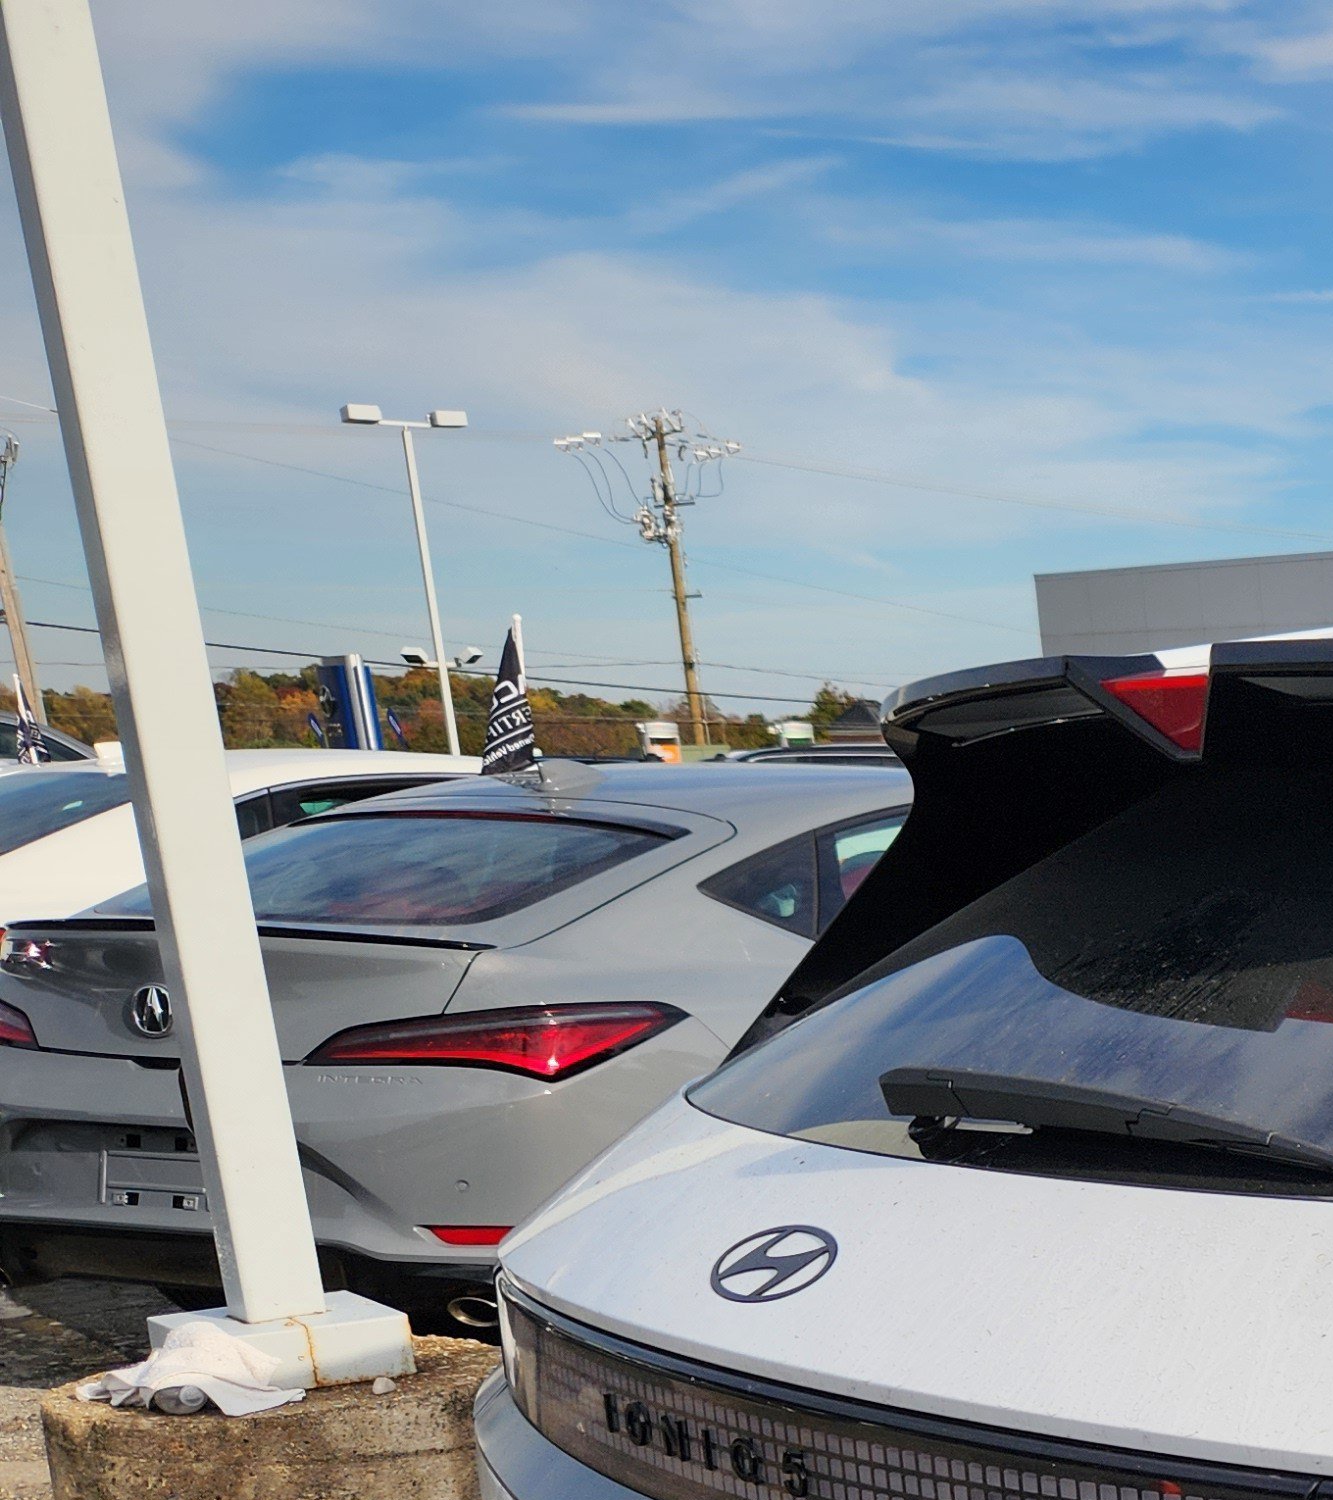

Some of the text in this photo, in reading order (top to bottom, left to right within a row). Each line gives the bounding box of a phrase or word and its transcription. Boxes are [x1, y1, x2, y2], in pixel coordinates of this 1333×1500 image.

[317, 1074, 423, 1085] INTEGRA
[603, 1393, 809, 1498] IONIQ 5
